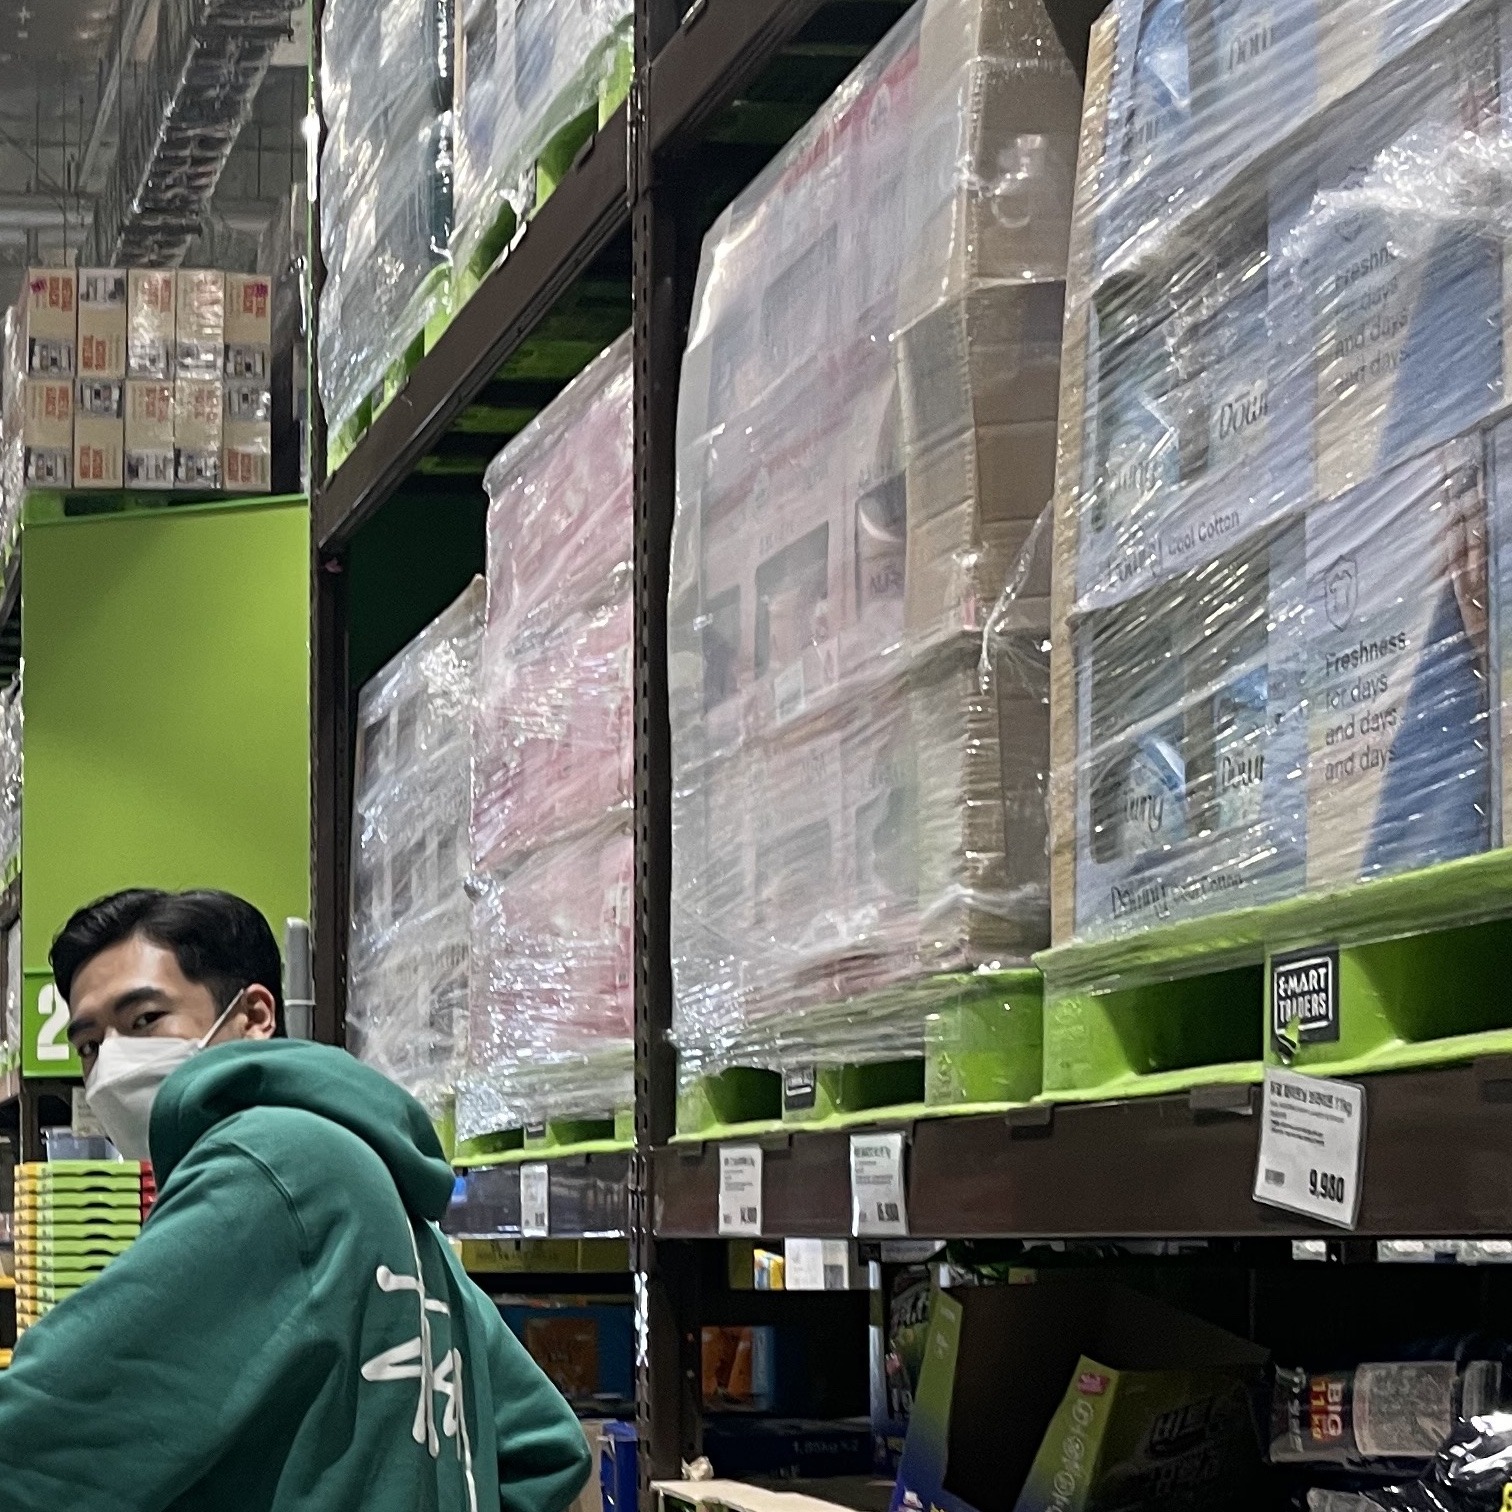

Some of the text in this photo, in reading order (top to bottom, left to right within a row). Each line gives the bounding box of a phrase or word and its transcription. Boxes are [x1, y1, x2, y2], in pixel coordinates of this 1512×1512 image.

[1335, 249, 1392, 287] Freshn
[1199, 511, 1240, 543] Cotton
[1325, 631, 1407, 677] Freshness
[1351, 673, 1390, 705] days
[1325, 706, 1399, 746] and days
[1324, 745, 1396, 781] and days
[1110, 875, 1170, 920] Downy
[1309, 1168, 1345, 1204] 9,980
[1327, 1382, 1344, 1437] BIG
